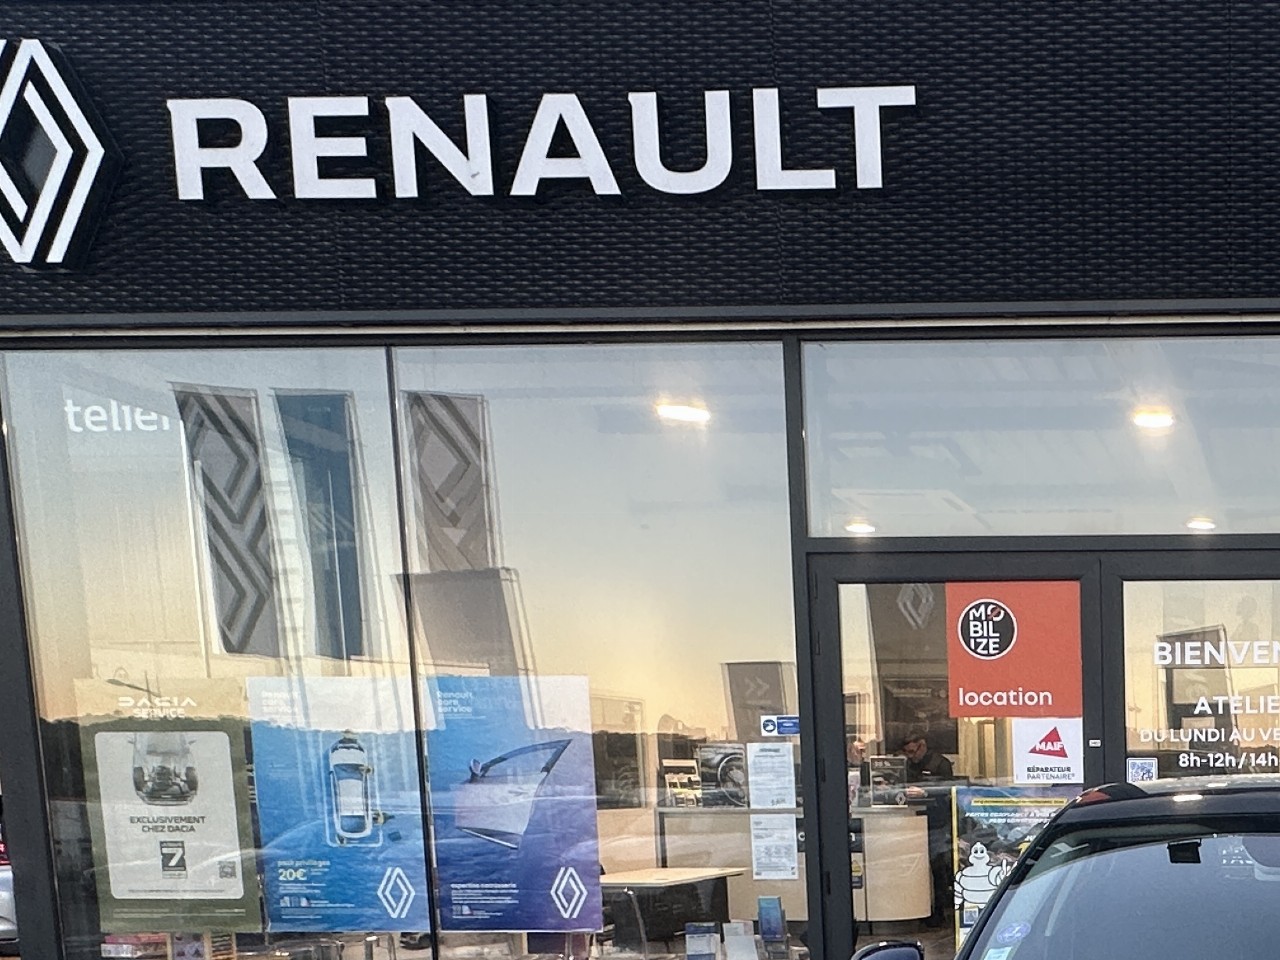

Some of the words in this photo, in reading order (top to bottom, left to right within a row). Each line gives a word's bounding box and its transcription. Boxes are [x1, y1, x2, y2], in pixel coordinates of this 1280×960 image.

[167, 85, 916, 200] RENAULT
[958, 687, 1053, 706] location
[1140, 729, 1167, 743] DU
[1170, 728, 1225, 743] LUNDI
[1229, 727, 1255, 742] AU
[130, 816, 206, 825] EXCLUSIVEMENT
[141, 825, 166, 833] CHEZ
[167, 825, 196, 833] DACIA
[161, 847, 184, 867] 7
